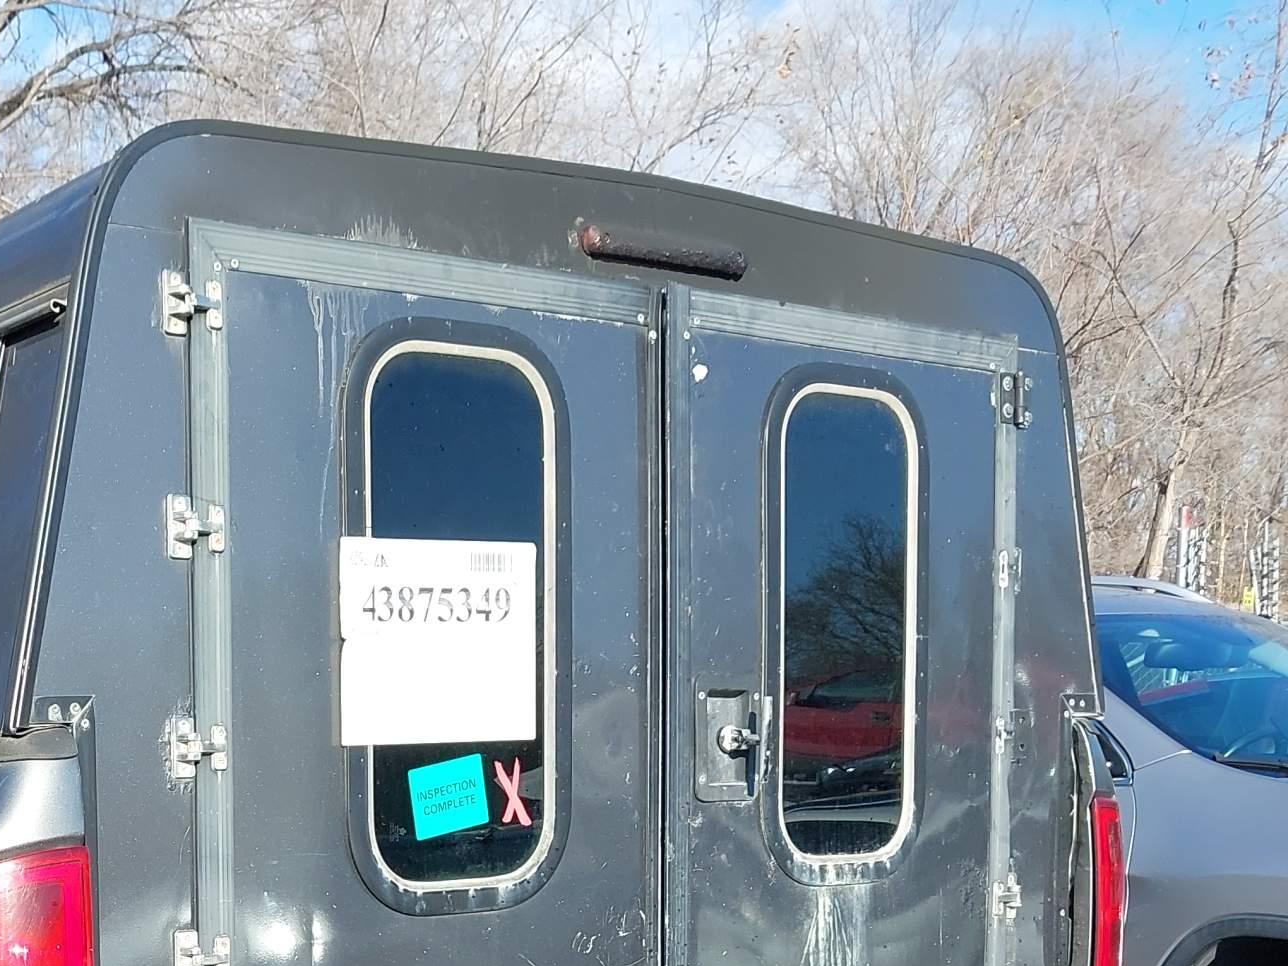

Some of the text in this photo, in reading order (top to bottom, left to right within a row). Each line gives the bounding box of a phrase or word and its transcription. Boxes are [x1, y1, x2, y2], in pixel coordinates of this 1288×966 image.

[362, 585, 512, 623] 43875349
[415, 777, 477, 803] INSPECTION
[422, 794, 477, 817] COMPLETE
